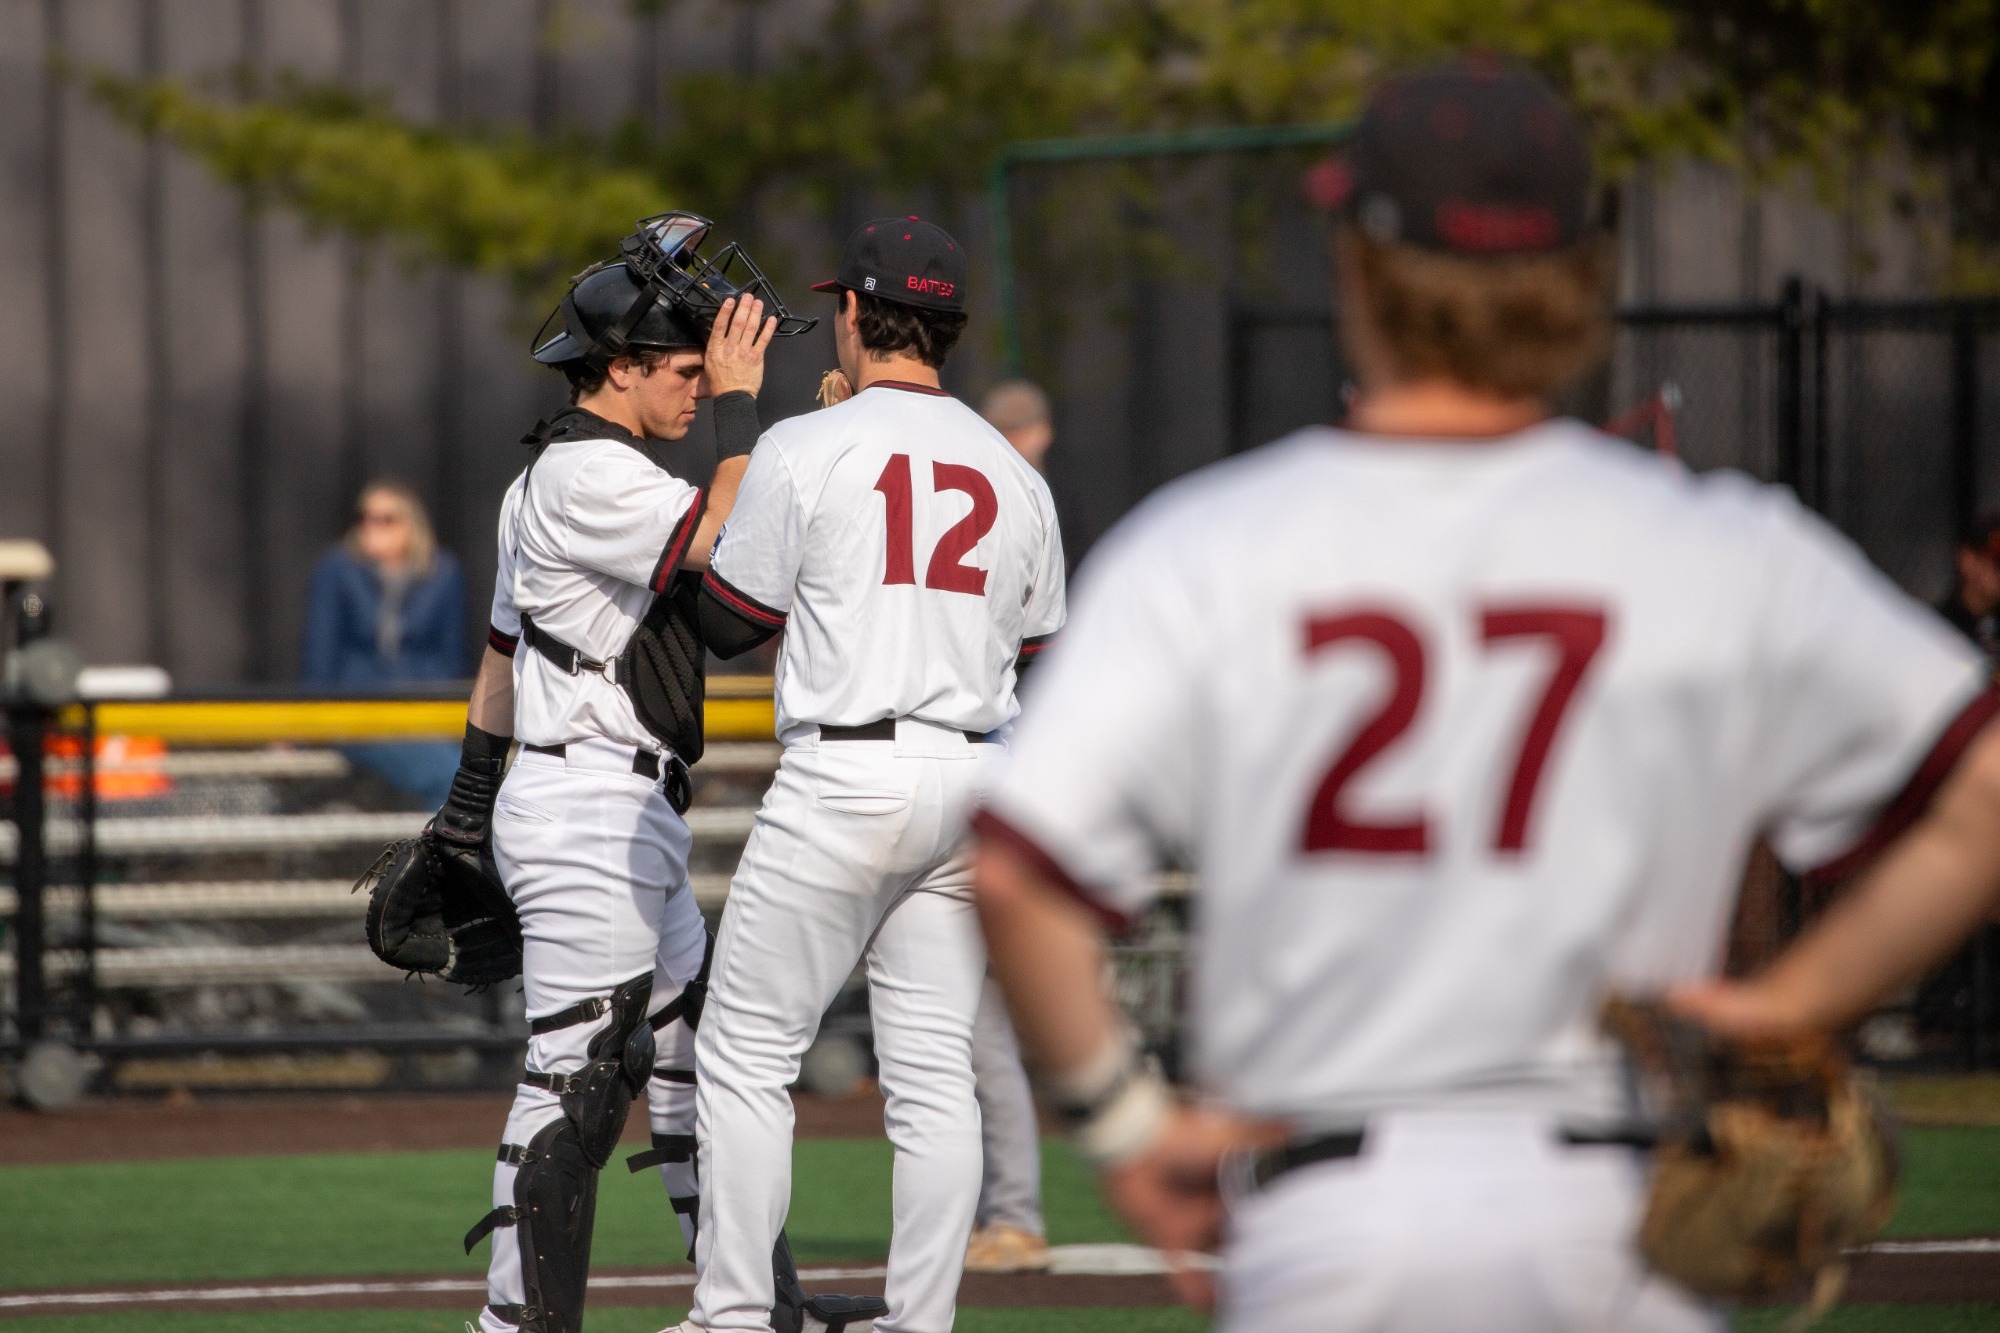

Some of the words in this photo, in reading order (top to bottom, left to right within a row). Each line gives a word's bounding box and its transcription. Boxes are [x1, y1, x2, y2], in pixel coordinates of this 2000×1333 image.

[907, 276, 954, 296] BATES
[874, 453, 999, 596] 12
[1302, 603, 1611, 856] 27
